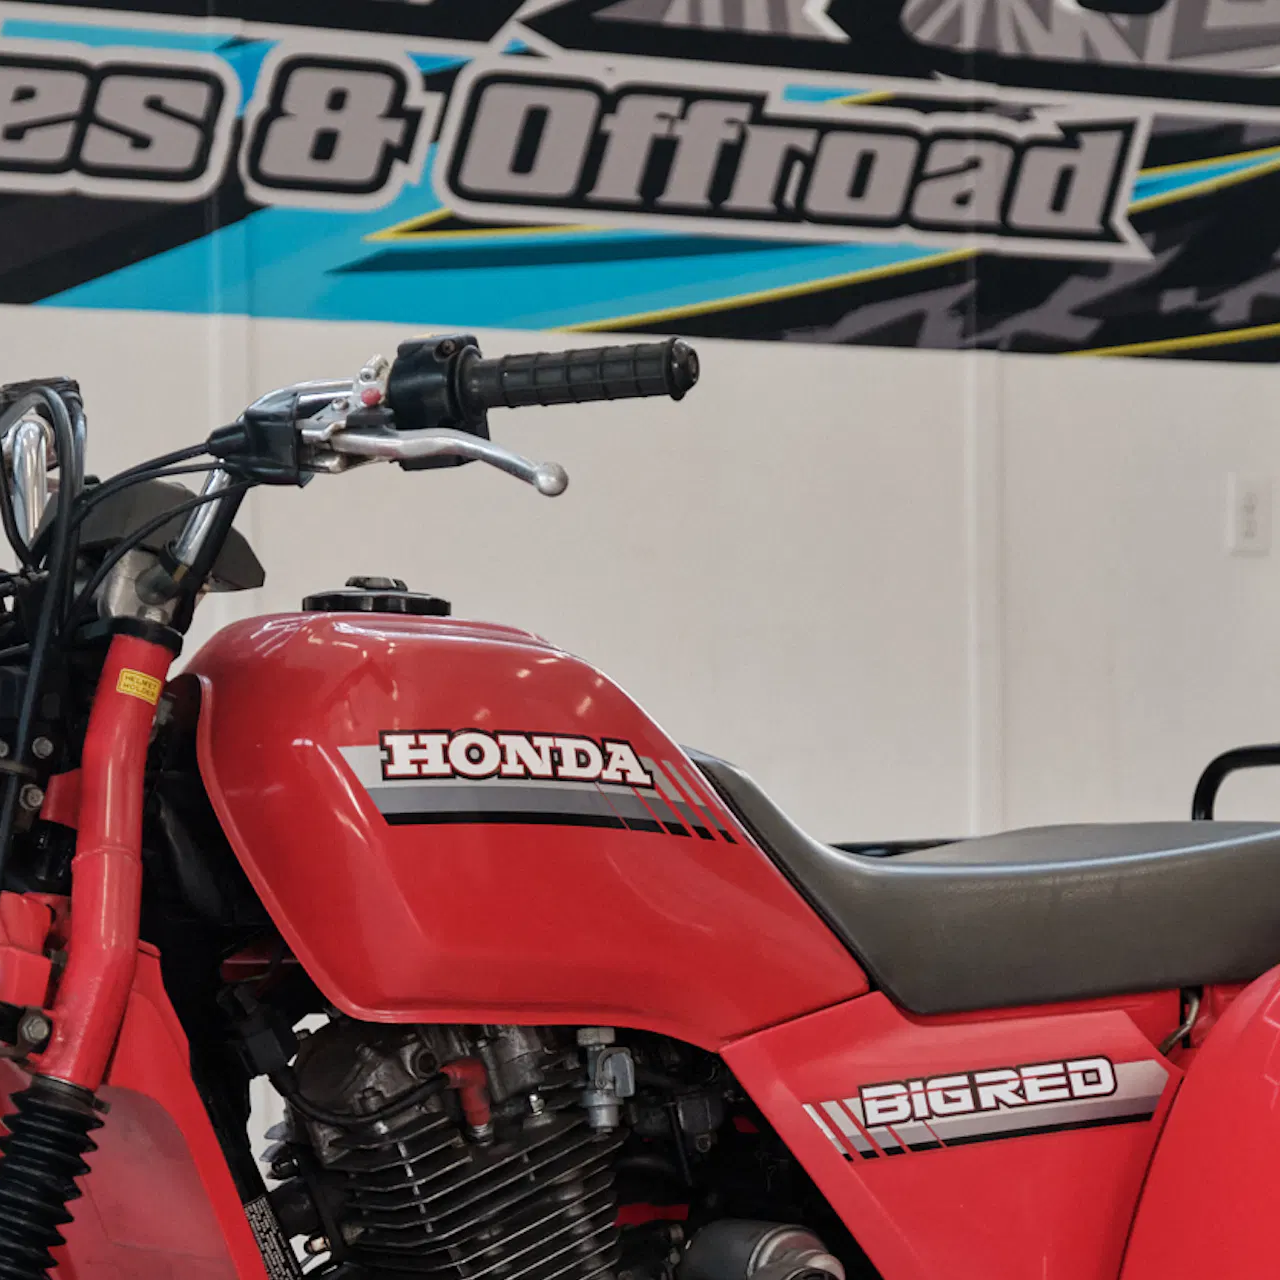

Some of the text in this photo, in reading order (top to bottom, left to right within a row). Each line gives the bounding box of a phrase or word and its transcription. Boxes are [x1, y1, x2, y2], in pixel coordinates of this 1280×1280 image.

[252, 58, 422, 196] &
[450, 72, 1140, 238] Offroad
[380, 731, 654, 788] HONDA
[859, 1056, 1117, 1128] BIGRED
